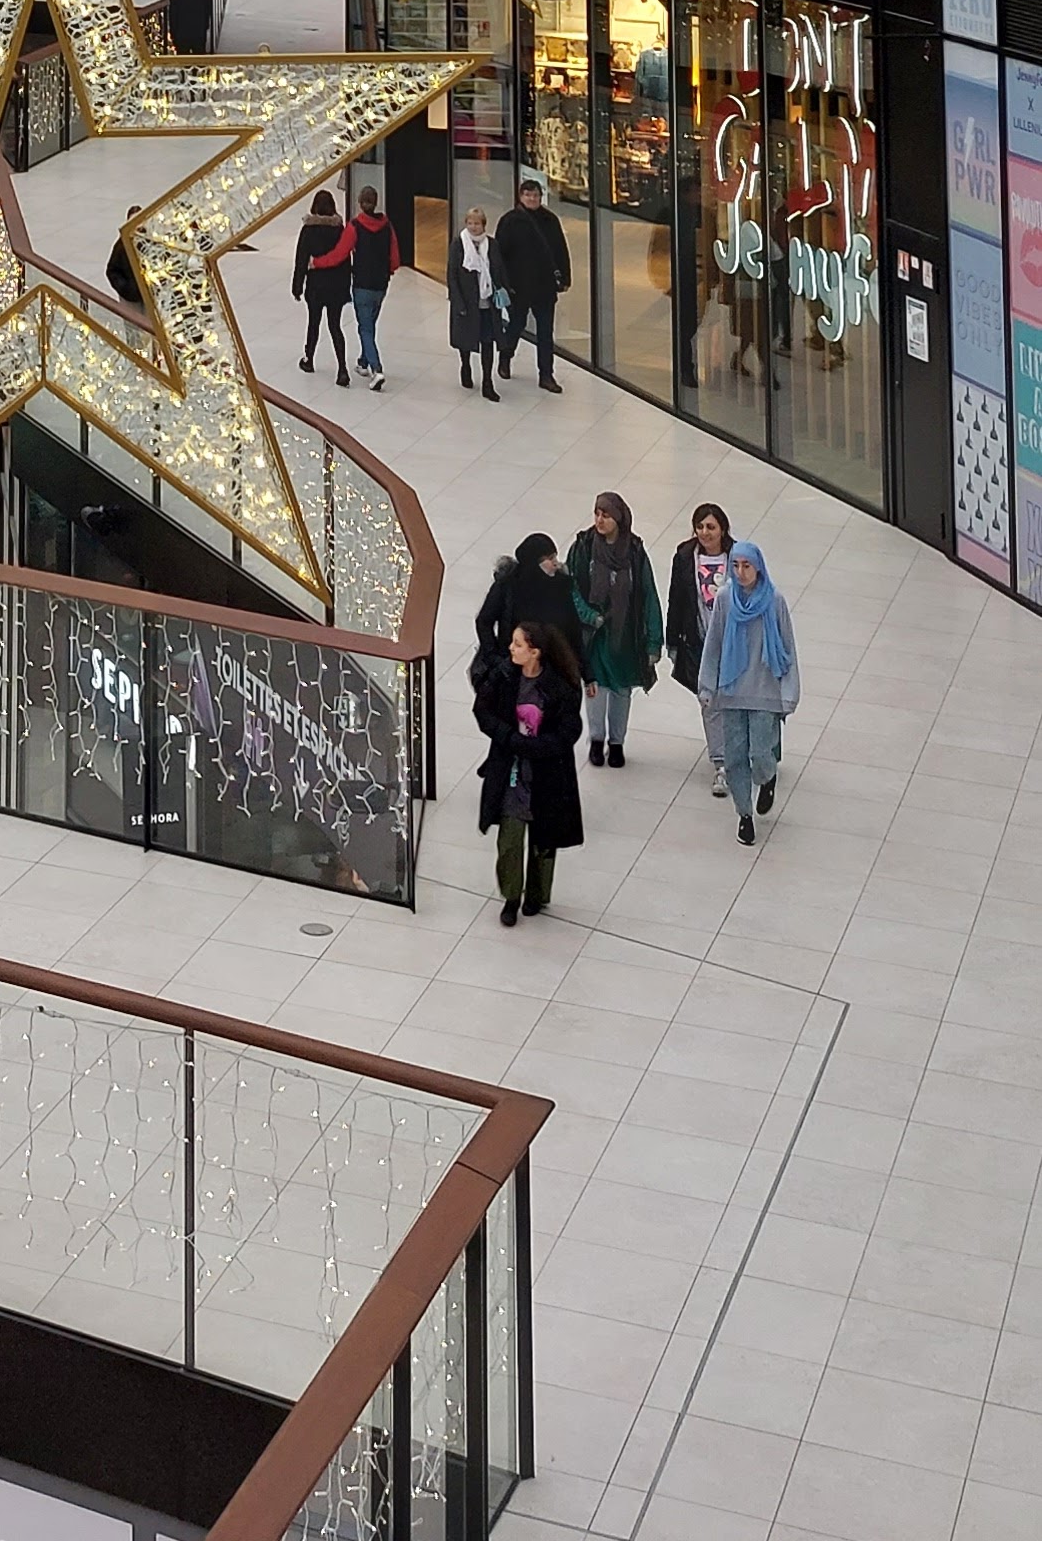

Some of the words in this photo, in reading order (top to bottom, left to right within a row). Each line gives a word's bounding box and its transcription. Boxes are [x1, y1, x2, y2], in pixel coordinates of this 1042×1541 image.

[954, 158, 996, 206] PWR
[956, 269, 1001, 303] GOOD
[957, 294, 1002, 330] VIBES
[131, 812, 180, 826] SEHORA
